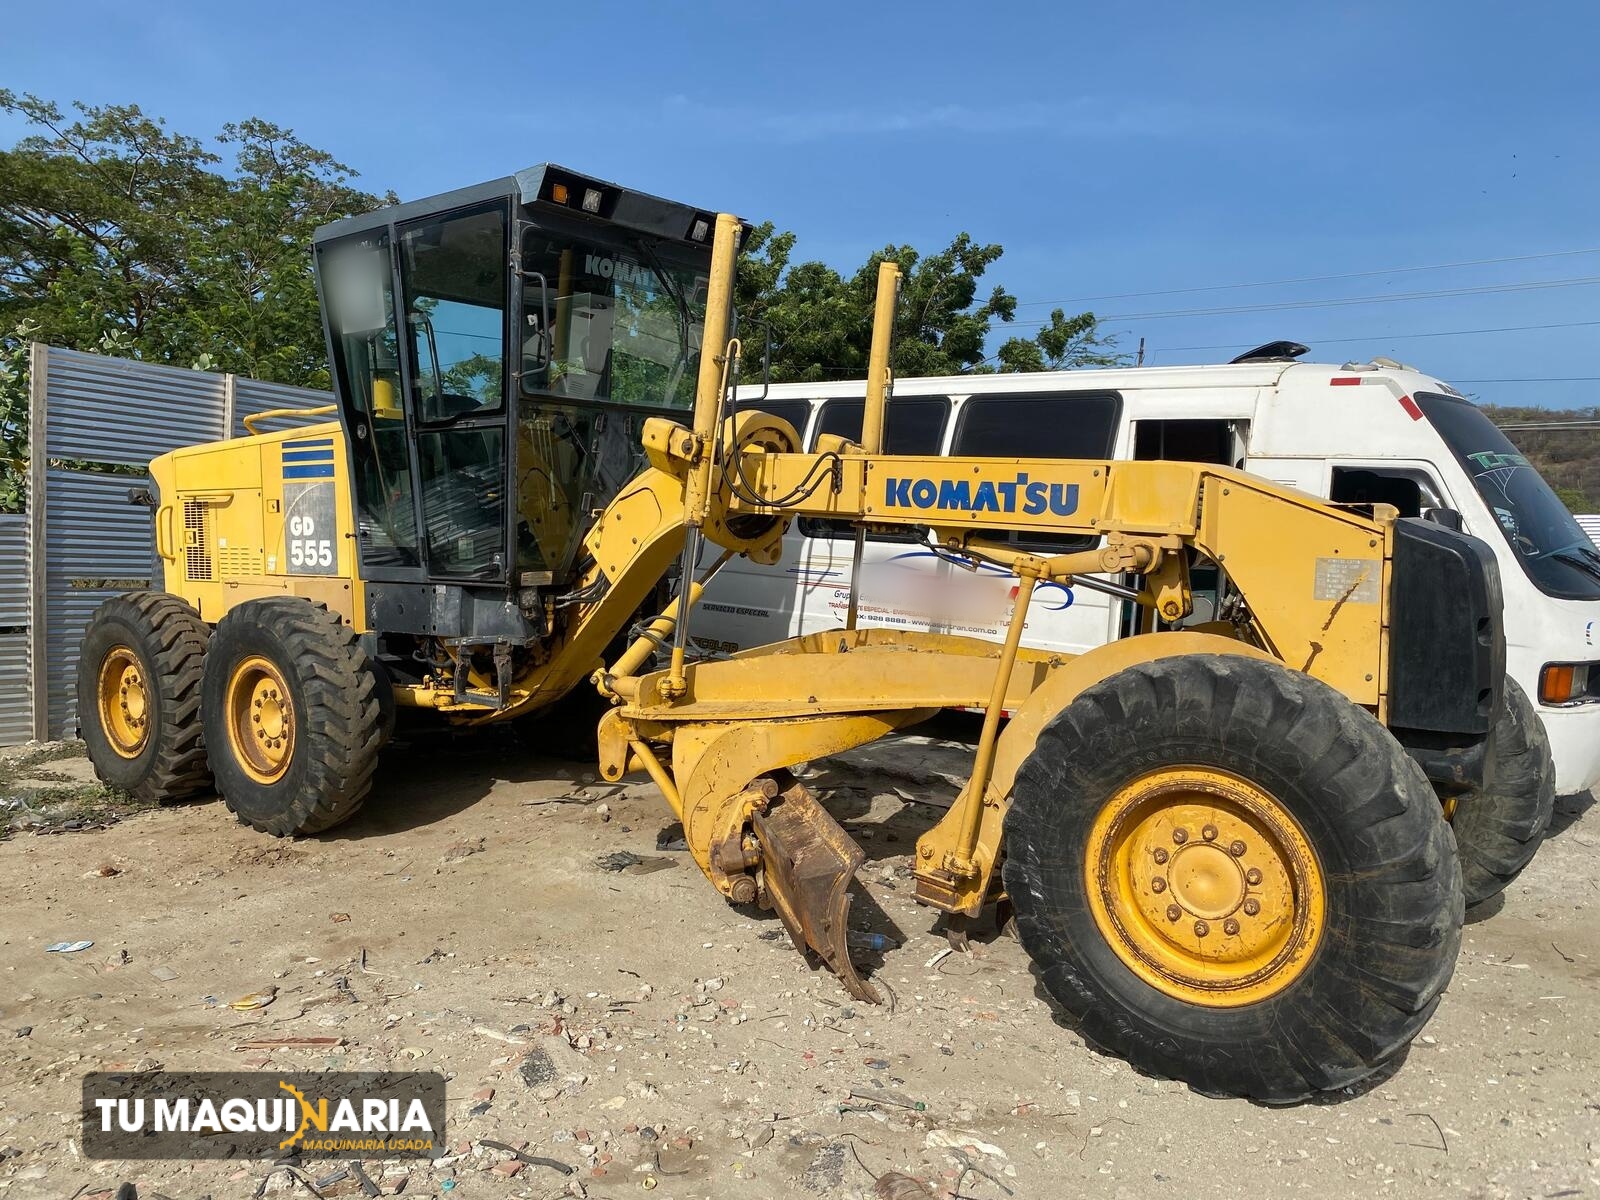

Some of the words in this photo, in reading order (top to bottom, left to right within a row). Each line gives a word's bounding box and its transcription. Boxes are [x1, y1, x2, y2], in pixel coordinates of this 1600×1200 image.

[885, 472, 1080, 517] KOMATSU
[290, 516, 315, 536] GD
[290, 540, 333, 567] 555
[736, 607, 769, 618] ESPECIAL
[688, 635, 739, 653] SCOLAR
